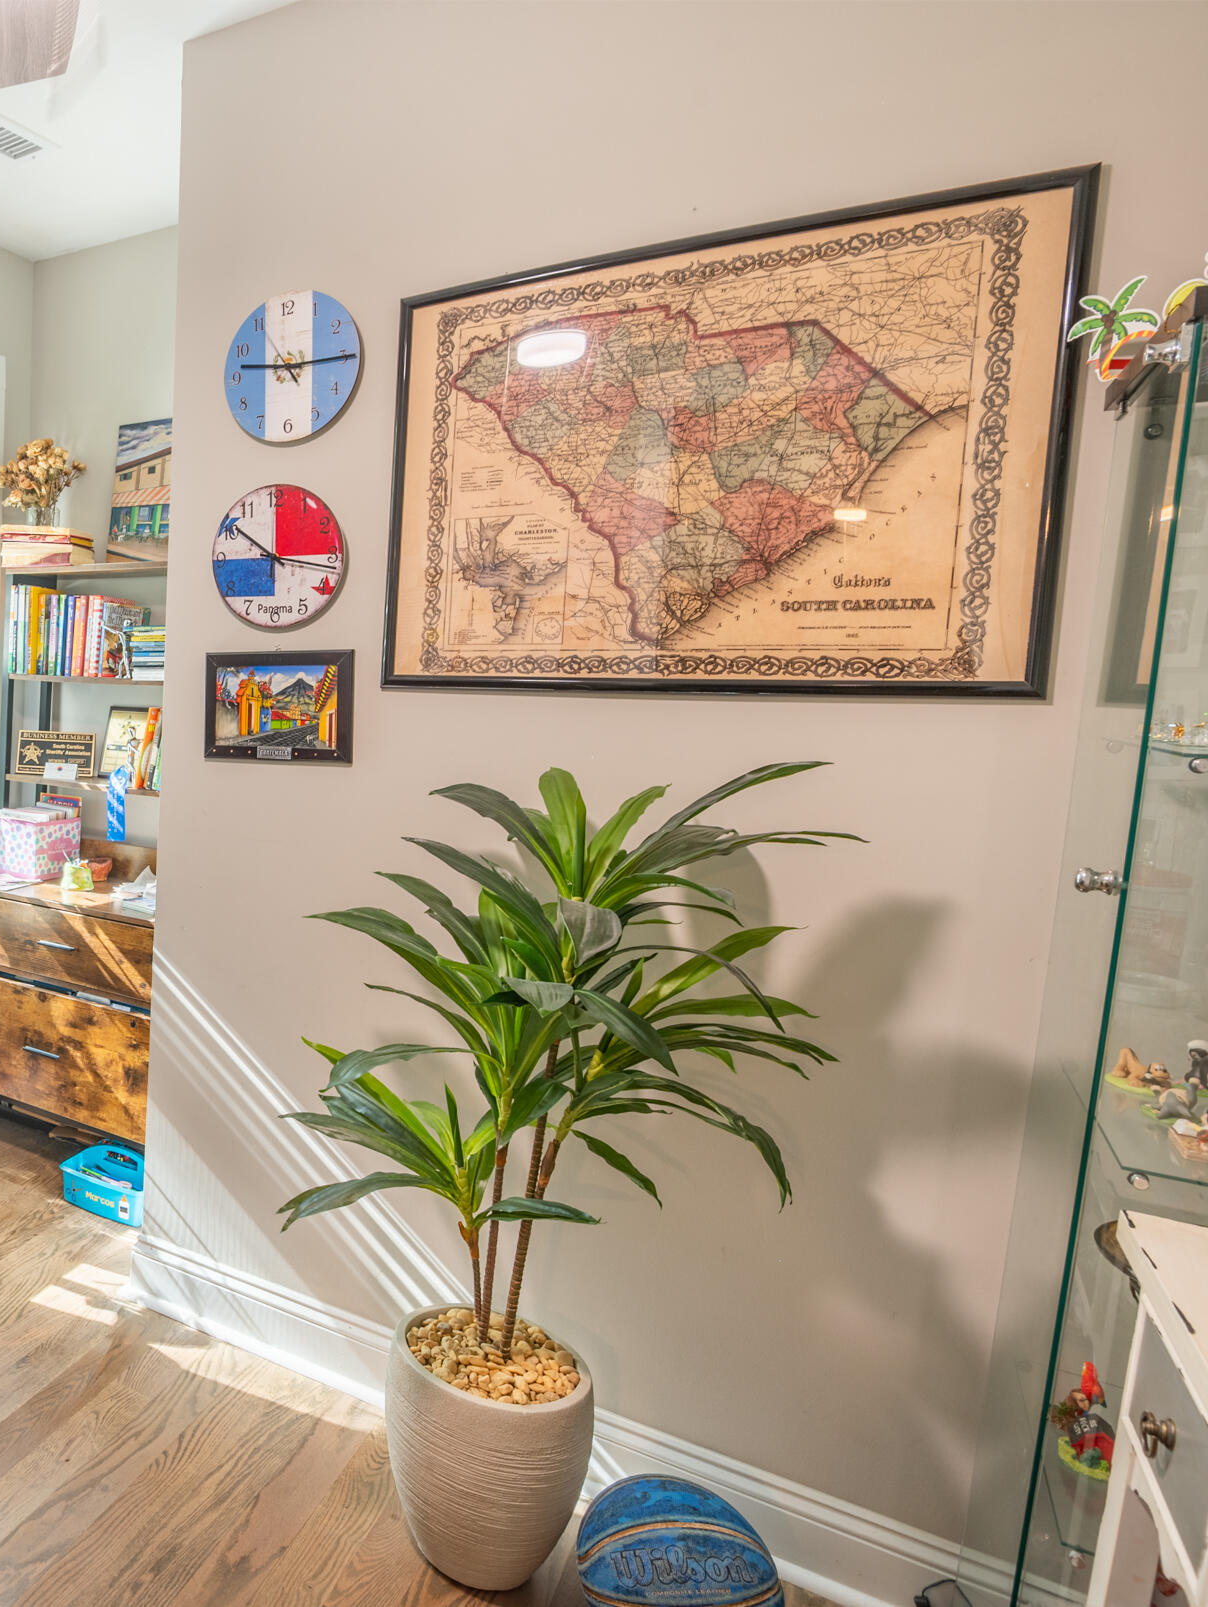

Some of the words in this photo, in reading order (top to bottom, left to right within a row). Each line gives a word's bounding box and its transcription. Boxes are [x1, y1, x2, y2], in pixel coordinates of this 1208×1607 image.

[281, 300, 295, 316] 12
[313, 302, 318, 316] 1
[254, 317, 264, 332] 11
[331, 319, 341, 334] 2
[236, 343, 250, 358] 10
[232, 371, 242, 386] 9
[330, 381, 338, 396] 4
[240, 397, 248, 411] 8
[256, 415, 264, 430] 7
[311, 407, 320, 422] 5
[283, 418, 293, 434] 6
[267, 489, 284, 508] 12
[302, 496, 306, 514] 1
[240, 501, 254, 518] 11
[224, 524, 238, 541] 10
[319, 516, 330, 534] 2
[216, 552, 226, 568] 9
[327, 546, 338, 564] 3
[226, 580, 236, 598] 8
[317, 577, 326, 596] 4
[832, 574, 891, 588] Colton's
[244, 600, 254, 616] 7
[258, 604, 292, 614] Panama
[298, 598, 308, 616] 5
[780, 600, 838, 612] SOUTH
[842, 598, 936, 612] CAROLINA
[270, 606, 280, 624] 6
[85, 1190, 115, 1208] Marcos
[610, 1544, 755, 1589] Wilson
